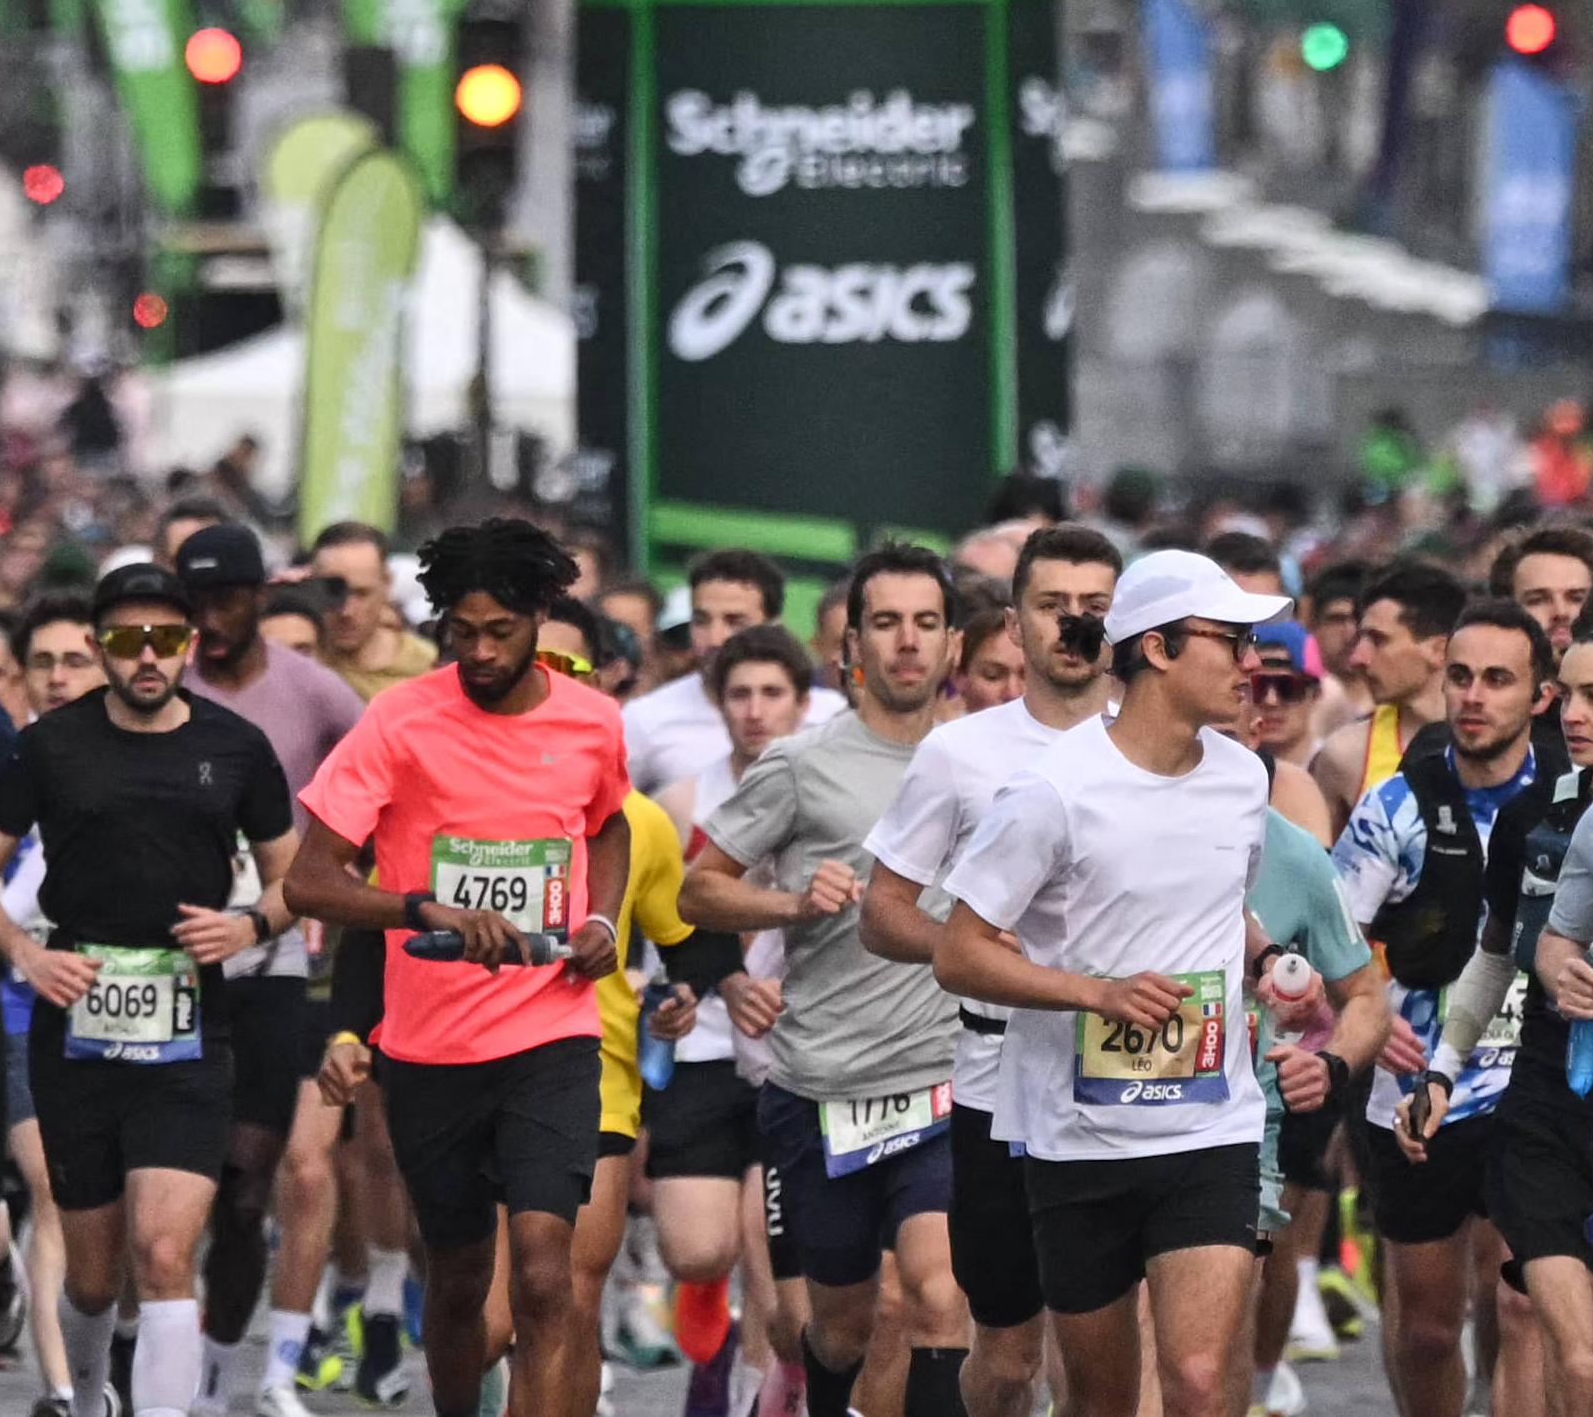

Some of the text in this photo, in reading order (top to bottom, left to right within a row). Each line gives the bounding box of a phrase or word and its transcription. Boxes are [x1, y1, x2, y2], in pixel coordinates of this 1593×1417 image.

[666, 88, 974, 156] Schneider
[449, 838, 534, 856] Schneider
[454, 874, 527, 912] 4769
[87, 982, 157, 1018] 6069
[1143, 1084, 1181, 1100] asics
